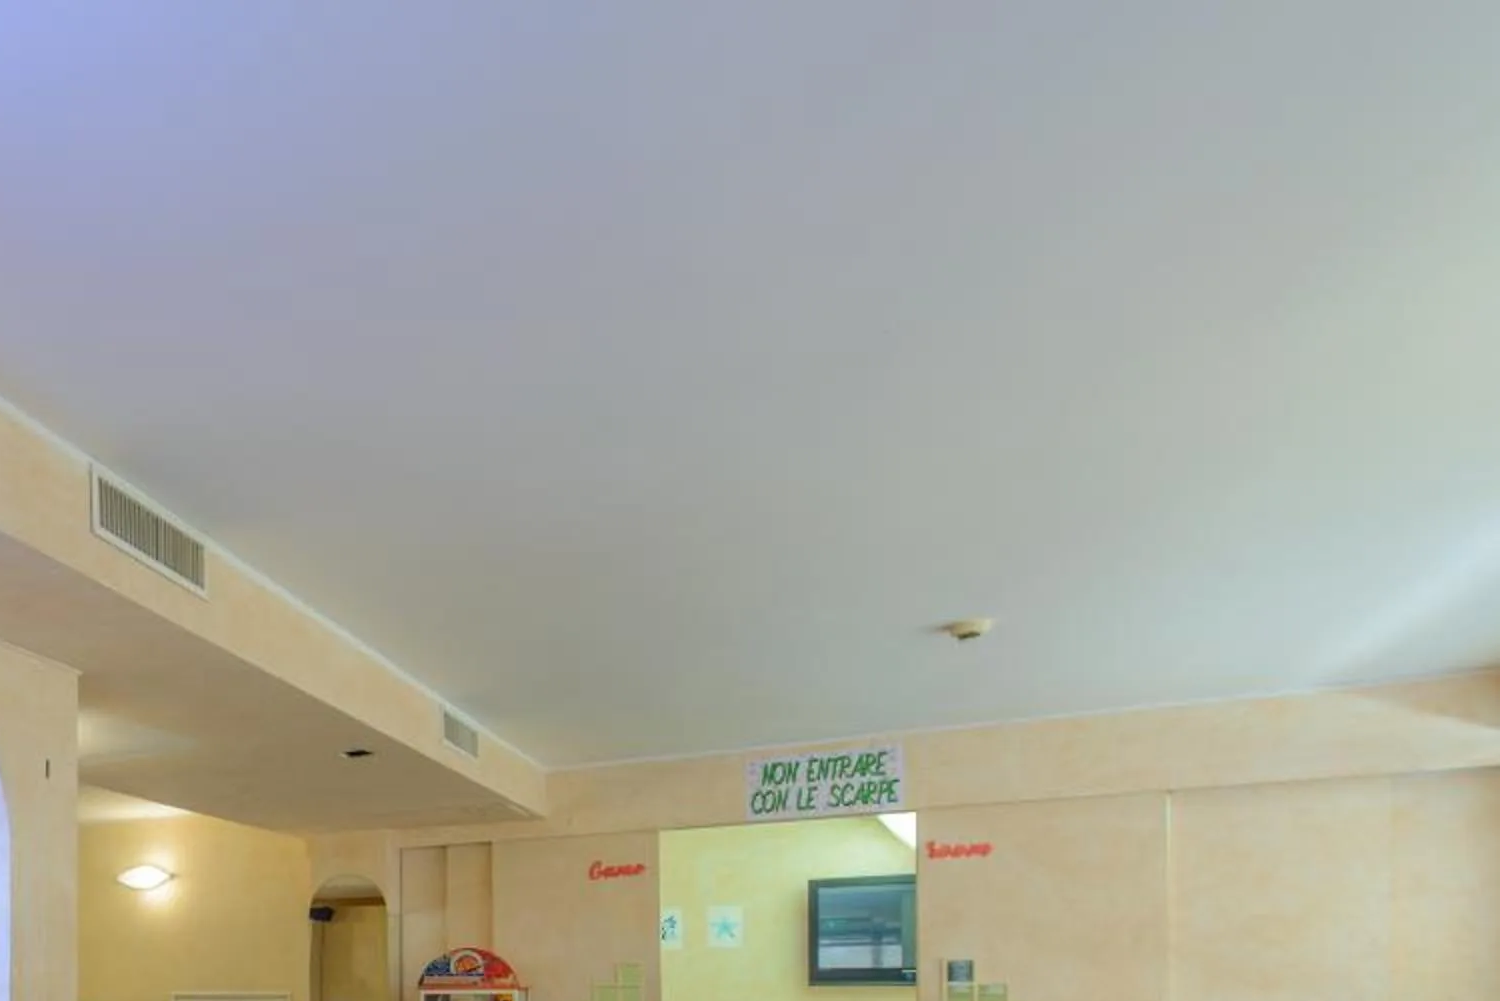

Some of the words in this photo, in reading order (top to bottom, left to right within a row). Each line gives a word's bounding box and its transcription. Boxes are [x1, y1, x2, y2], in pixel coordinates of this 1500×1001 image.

[761, 761, 800, 786] NON
[806, 751, 888, 783] ENTRARE
[750, 787, 790, 815] CON
[796, 786, 818, 811] LE
[827, 779, 900, 808] SCARPE
